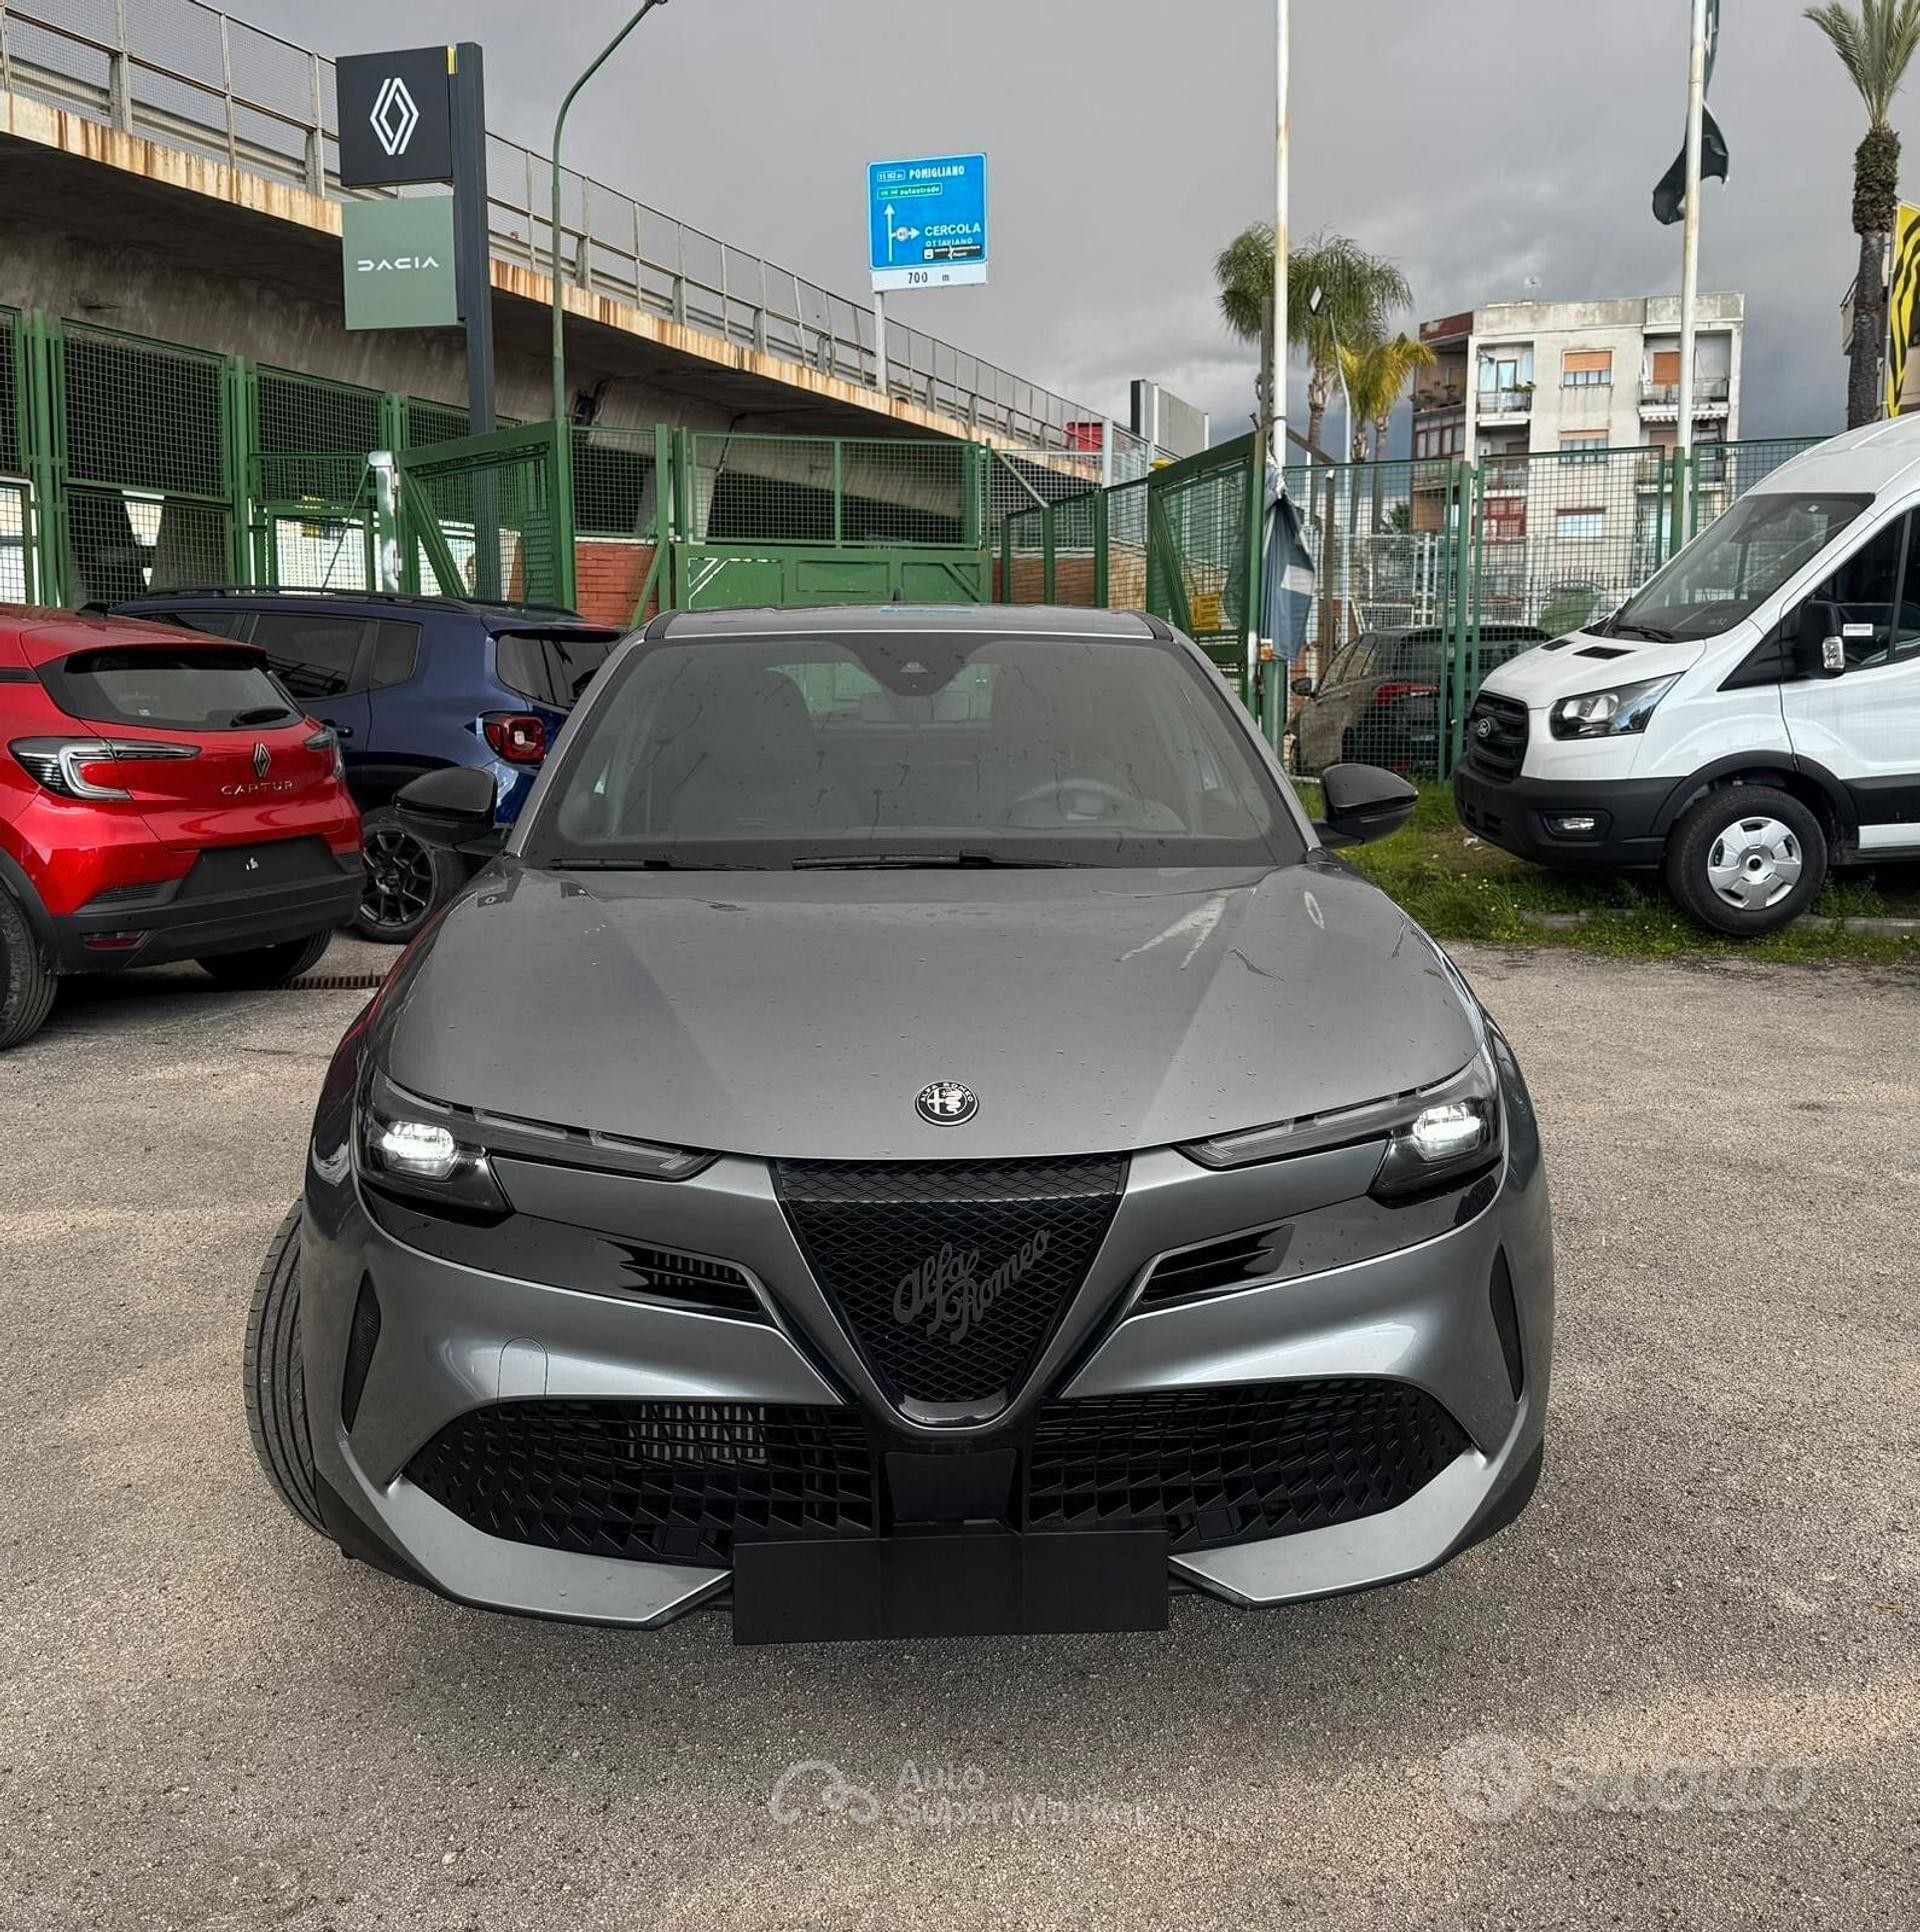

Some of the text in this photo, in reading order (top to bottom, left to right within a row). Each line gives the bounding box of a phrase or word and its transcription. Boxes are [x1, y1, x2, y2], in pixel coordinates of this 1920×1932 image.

[908, 165, 965, 180] POMIGLIANO
[924, 222, 981, 237] CERCOLA
[925, 237, 973, 248] OTTAVIANO
[357, 256, 439, 272] DACIA
[908, 271, 928, 284] 700
[220, 781, 295, 796] CAPTUR
[920, 1082, 974, 1102] ALFA ROMEO
[892, 1229, 1051, 1345] Alfa Romeo
